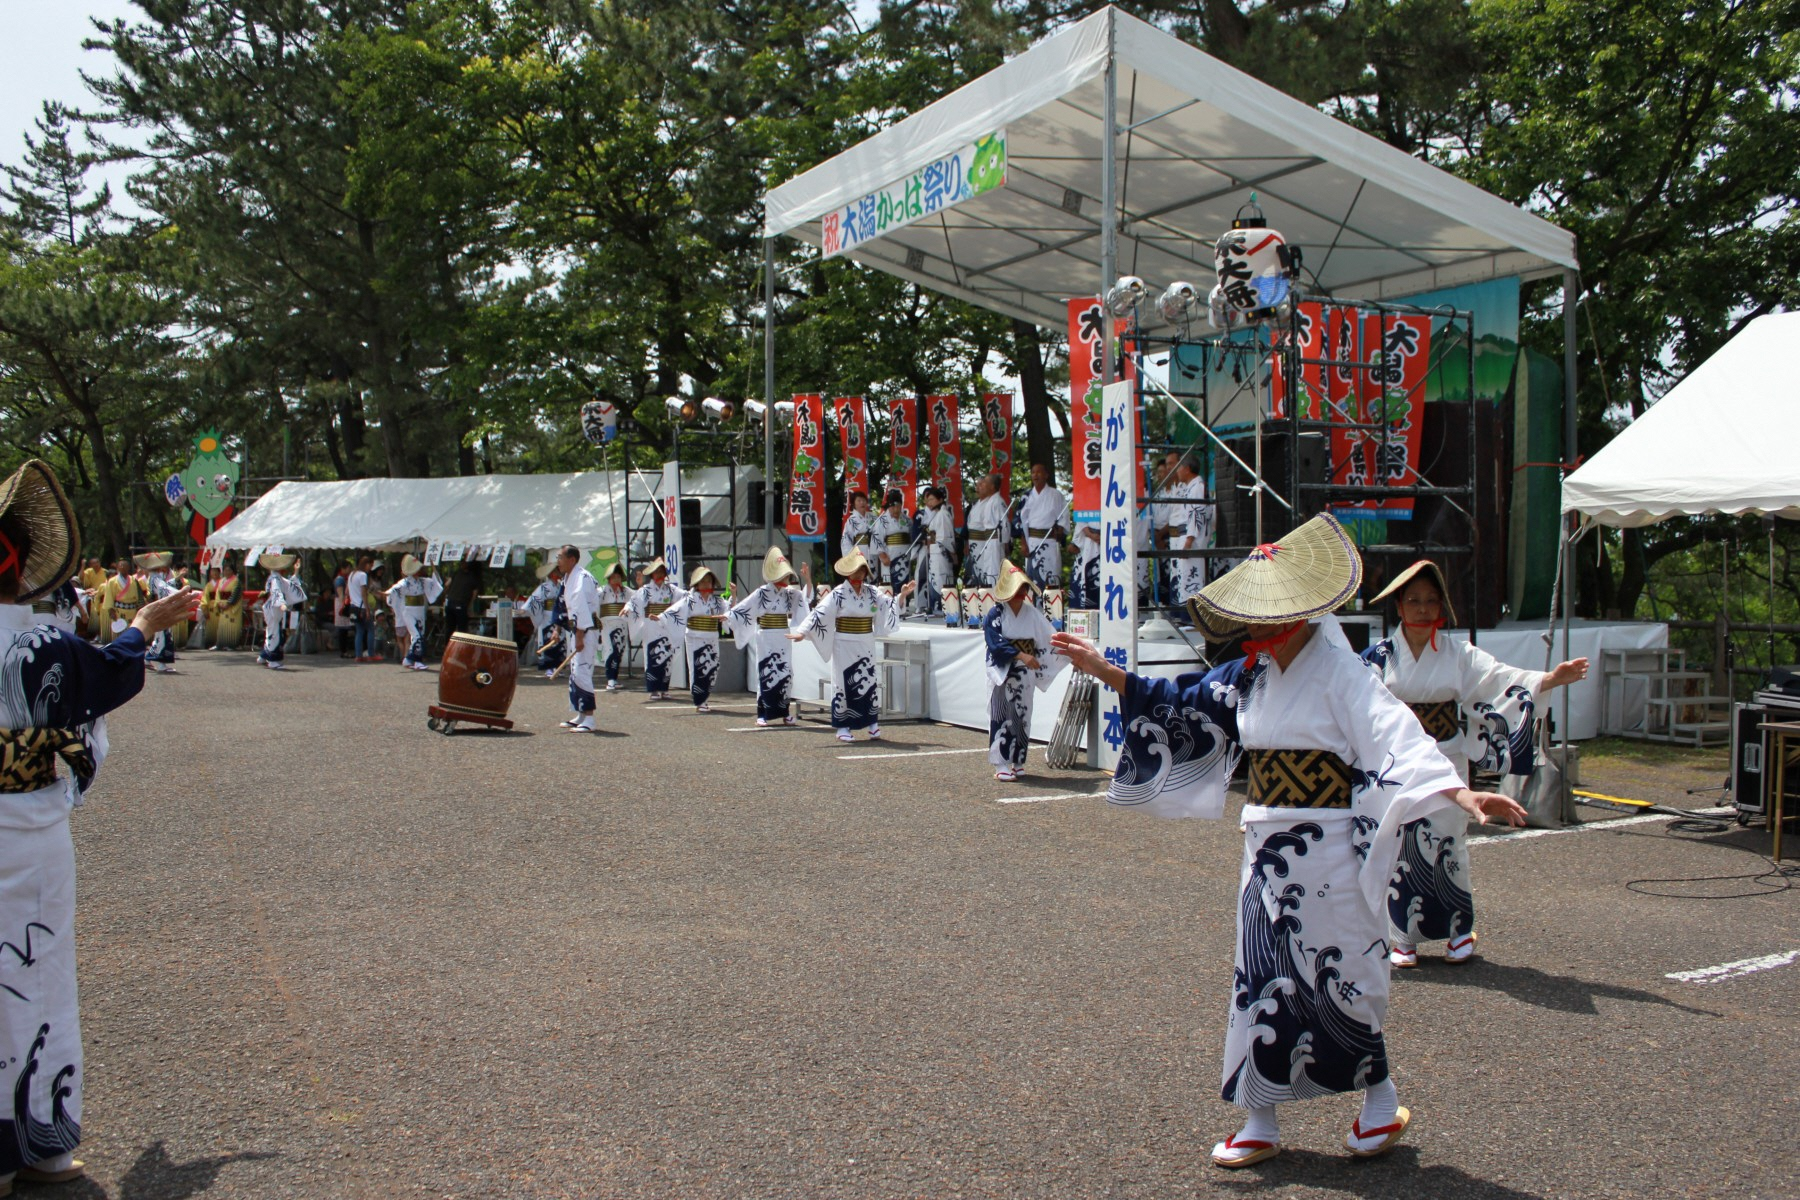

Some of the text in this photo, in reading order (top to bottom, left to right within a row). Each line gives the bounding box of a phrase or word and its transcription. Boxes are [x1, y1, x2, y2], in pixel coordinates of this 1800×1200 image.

[665, 495, 677, 529] 祝
[1104, 402, 1129, 621] がんばれ
[493, 545, 507, 565] 本部
[665, 544, 678, 576] 30
